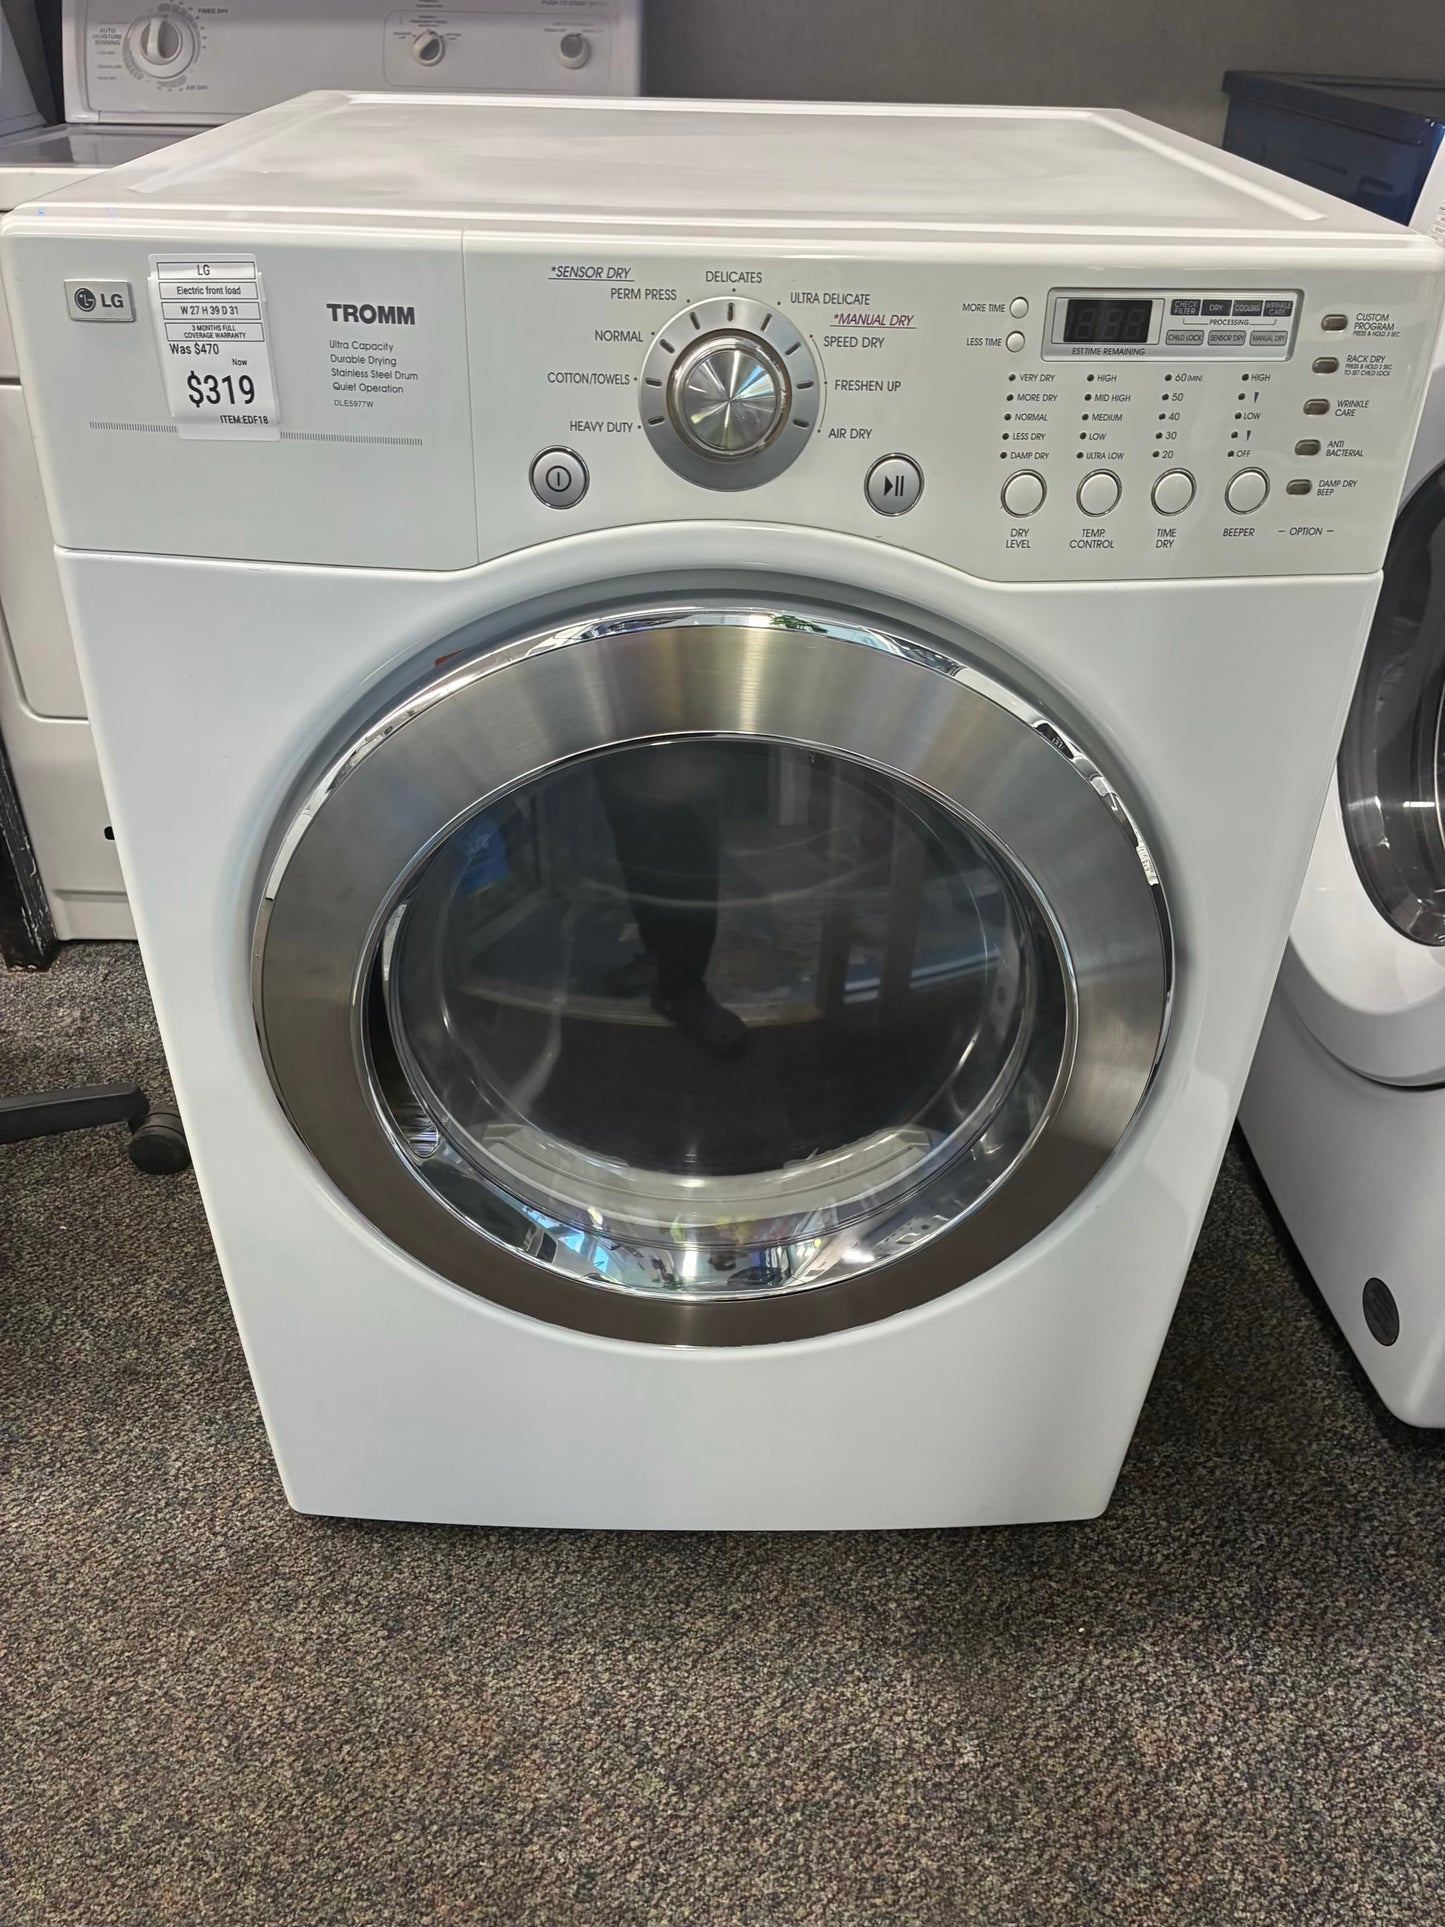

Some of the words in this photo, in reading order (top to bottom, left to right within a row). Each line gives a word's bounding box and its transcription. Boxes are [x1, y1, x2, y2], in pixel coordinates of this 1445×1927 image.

[196, 264, 211, 276] LG
[606, 266, 631, 280] DRY
[705, 270, 763, 284] DELICATES
[176, 286, 205, 295] Electric
[206, 286, 224, 295] front
[225, 286, 242, 295] load
[610, 287, 641, 301] PERM
[644, 288, 677, 302] PRESS
[100, 293, 124, 308] LG
[790, 292, 820, 305] ULTRA
[823, 292, 871, 306] DELICATE
[180, 306, 189, 315] W
[189, 306, 200, 315] 27
[202, 306, 209, 315] H
[210, 306, 220, 315] 39
[222, 306, 228, 315] D
[229, 306, 239, 315] 31
[962, 303, 986, 313] MORE
[988, 303, 1005, 313] TIME
[1208, 304, 1224, 312] DRY
[1234, 304, 1261, 312] COOLING
[326, 303, 416, 326] TROMM
[1356, 312, 1390, 322] CUSTOM
[889, 314, 915, 327] DRY
[1209, 318, 1250, 326] PROCESSING
[1354, 322, 1395, 331] PROGRAM
[594, 329, 644, 343] NORMAL
[1168, 334, 1185, 342] CHILD
[1186, 334, 1202, 342] LOCK
[1209, 334, 1232, 342] SENSOR
[1233, 334, 1245, 342] DRY
[328, 339, 349, 350] Ultra
[351, 340, 394, 353] Capacity
[823, 336, 859, 348] SPEED
[861, 337, 885, 349] DRY
[966, 337, 983, 347] LESS
[984, 338, 1002, 347] TIME
[169, 343, 192, 355] Was
[194, 342, 220, 356] $470
[1103, 347, 1146, 356] REMAINING
[232, 358, 248, 366] Now
[330, 353, 366, 364] Durable
[367, 355, 397, 368] Drying
[1346, 354, 1369, 363] RACK
[1370, 355, 1386, 364] DRY
[331, 367, 369, 379] Stainless
[370, 369, 393, 380] Steel
[394, 370, 419, 381] Drum
[547, 371, 630, 386] COTTON/TOWELS
[1019, 373, 1038, 382] VERY
[1039, 373, 1056, 382] DRY
[1097, 373, 1117, 382] HIGH
[1250, 373, 1271, 382] HIGH
[186, 370, 255, 408] $319
[332, 381, 357, 392] Quiet
[358, 383, 404, 395] Operation
[834, 379, 884, 392] FRESHEN
[887, 380, 902, 392] UP
[1016, 393, 1041, 402] MORE
[1042, 393, 1058, 402] DRY
[1094, 393, 1110, 402] MID
[1111, 394, 1131, 402] HIGH
[1171, 392, 1184, 401] 50
[333, 399, 374, 408] DLE5977W
[1337, 400, 1370, 409] WRINKLE
[1168, 412, 1181, 421] 40
[1243, 412, 1261, 420] LOW
[1335, 408, 1356, 417] CARE
[219, 415, 269, 425] ITEM:EDF18
[1014, 413, 1048, 422] NORMAL
[1091, 413, 1123, 422] MEDIUM
[569, 420, 604, 434] HEAVY
[606, 422, 634, 434] DUTY
[828, 428, 847, 440] AIR
[850, 428, 873, 440] DRY
[1012, 432, 1030, 441] LESS
[1030, 432, 1046, 441] DRY
[1089, 432, 1107, 441] LOW
[1165, 431, 1178, 440] 30
[1327, 440, 1345, 448] ANTI
[1010, 451, 1034, 460] DAMP
[1034, 451, 1050, 460] DRY
[1086, 451, 1106, 460] ULTRA
[1107, 451, 1125, 460] LOW
[1162, 450, 1174, 459] 20
[1236, 449, 1251, 458] OFF
[1325, 449, 1364, 457] BACTERIAL
[1318, 480, 1341, 488] DAMP
[1342, 480, 1358, 488] DRY
[1316, 488, 1335, 496] BEEP
[1010, 528, 1029, 538] DRY
[1156, 528, 1177, 538] TIME
[1222, 527, 1256, 538] BEEPER
[1289, 527, 1323, 536] OPTION
[1005, 539, 1031, 549] LEVEL
[1069, 539, 1115, 549] CONTROL
[1155, 539, 1175, 549] DRY
